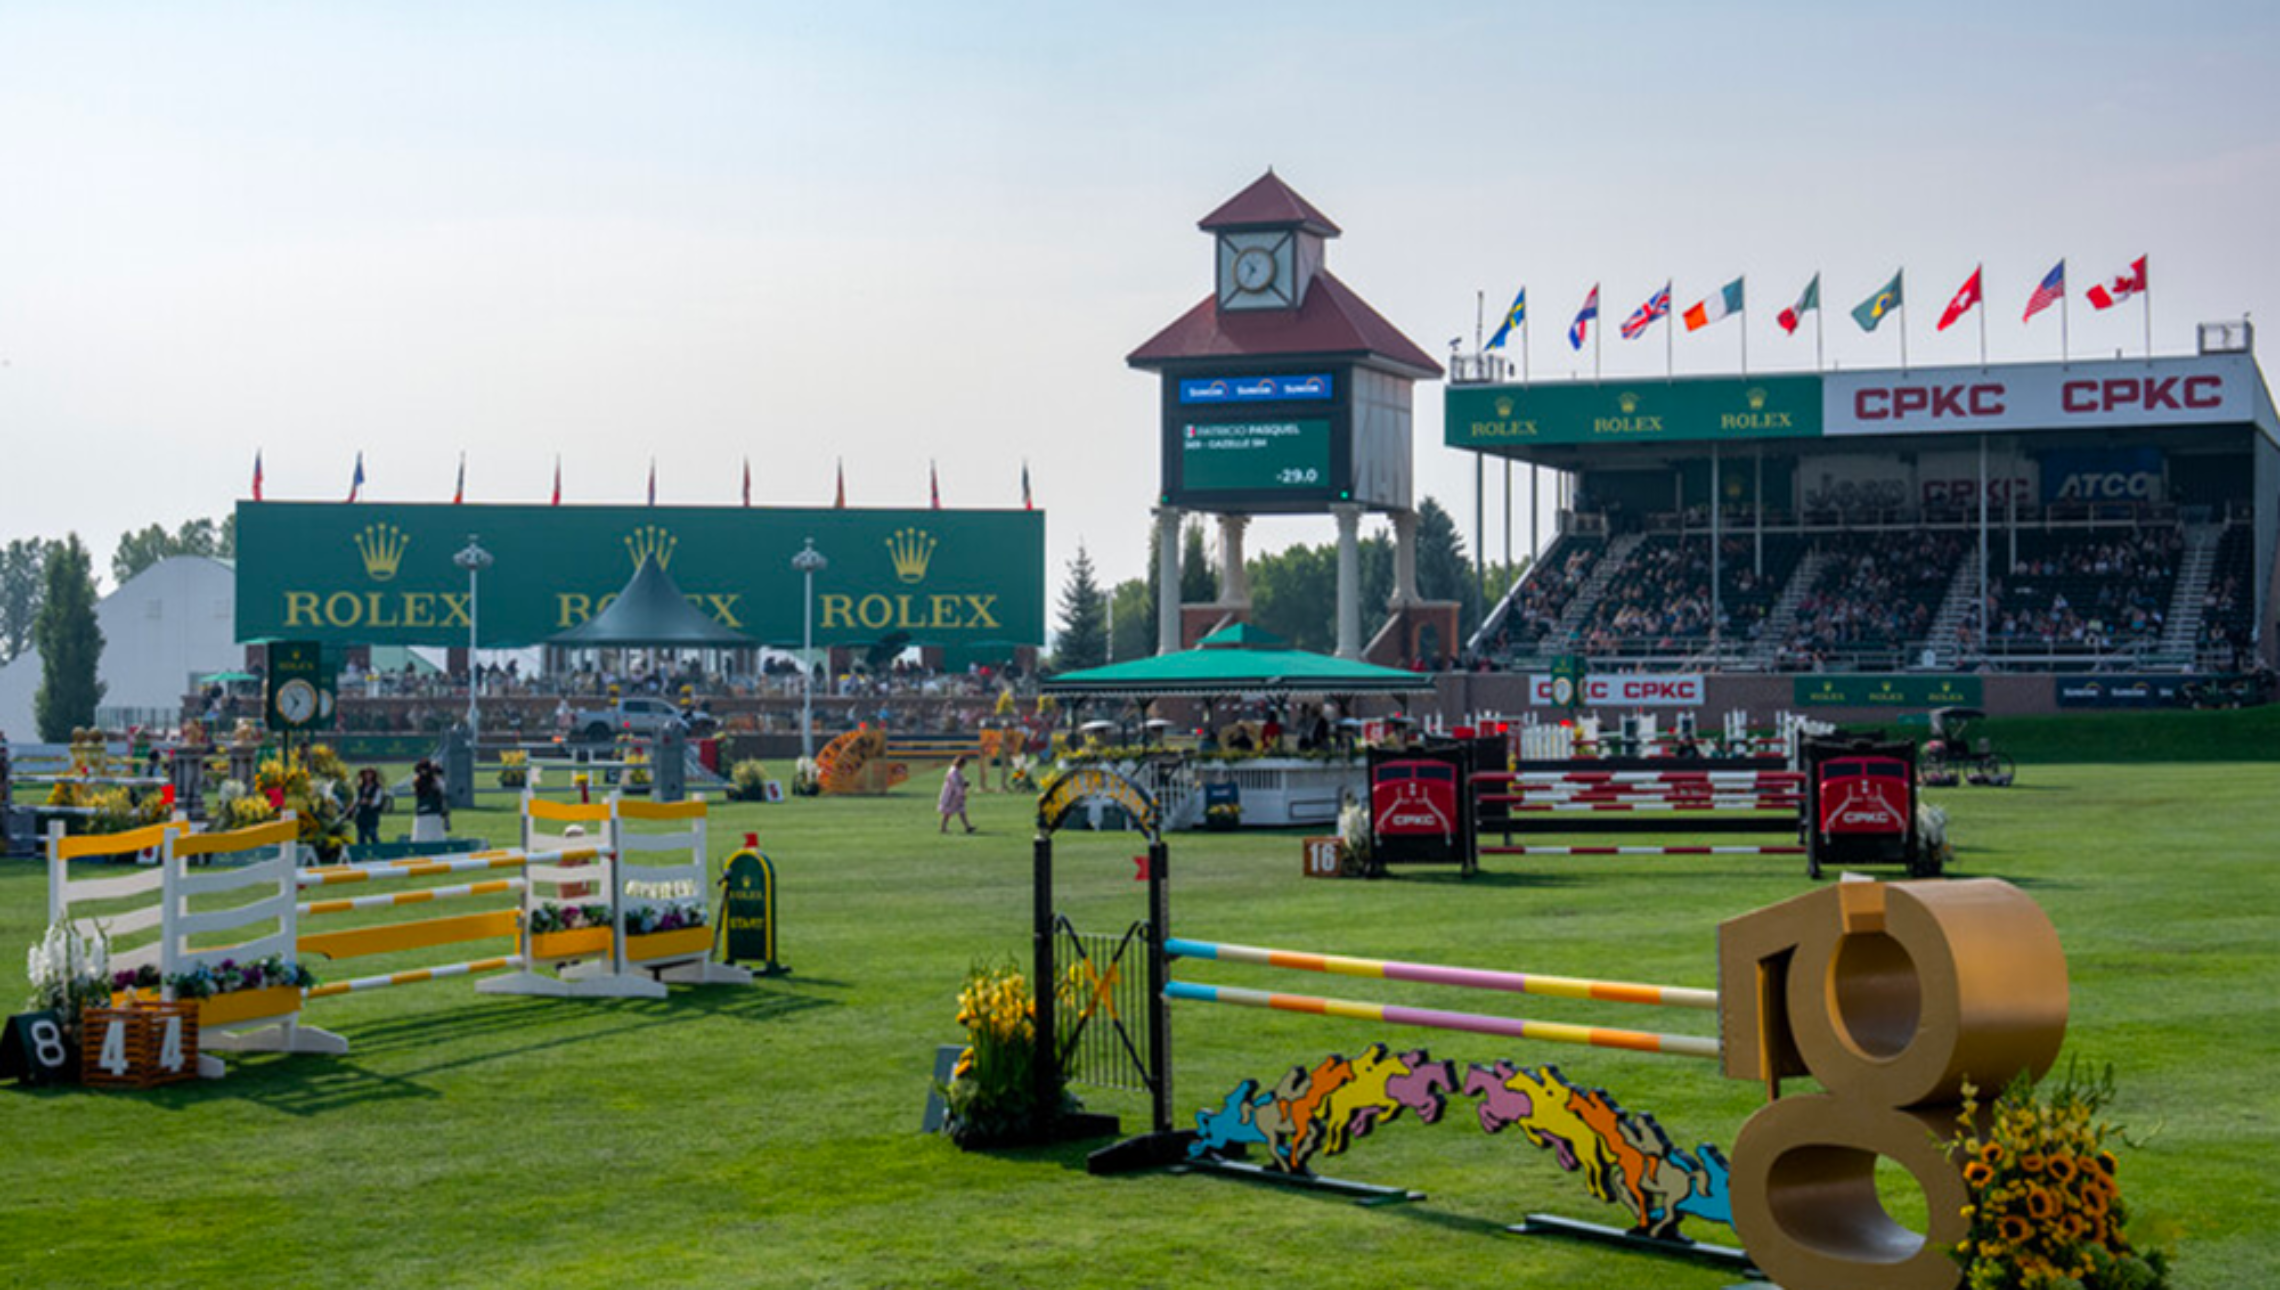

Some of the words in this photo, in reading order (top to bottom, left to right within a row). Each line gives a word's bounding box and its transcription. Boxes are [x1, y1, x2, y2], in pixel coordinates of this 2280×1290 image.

[1855, 384, 2006, 420] CPKC
[2061, 376, 2223, 413] CPKC
[1471, 420, 1537, 436] ROLEX
[1594, 416, 1662, 432] ROLEX
[1721, 412, 1793, 430] ROLEX
[1276, 468, 1318, 483] -29.0
[2058, 471, 2152, 498] ATCO
[1922, 478, 2029, 504] CPKC
[283, 591, 473, 627] ROLEX
[819, 594, 1002, 628] ROLEX
[1537, 681, 1608, 697] CC
[1623, 681, 1695, 697] CPKC
[1392, 814, 1435, 826] CPKC
[1843, 811, 1888, 823] CPKC
[30, 1020, 66, 1067] 8
[99, 1018, 130, 1077] 4
[159, 1014, 186, 1074] 4
